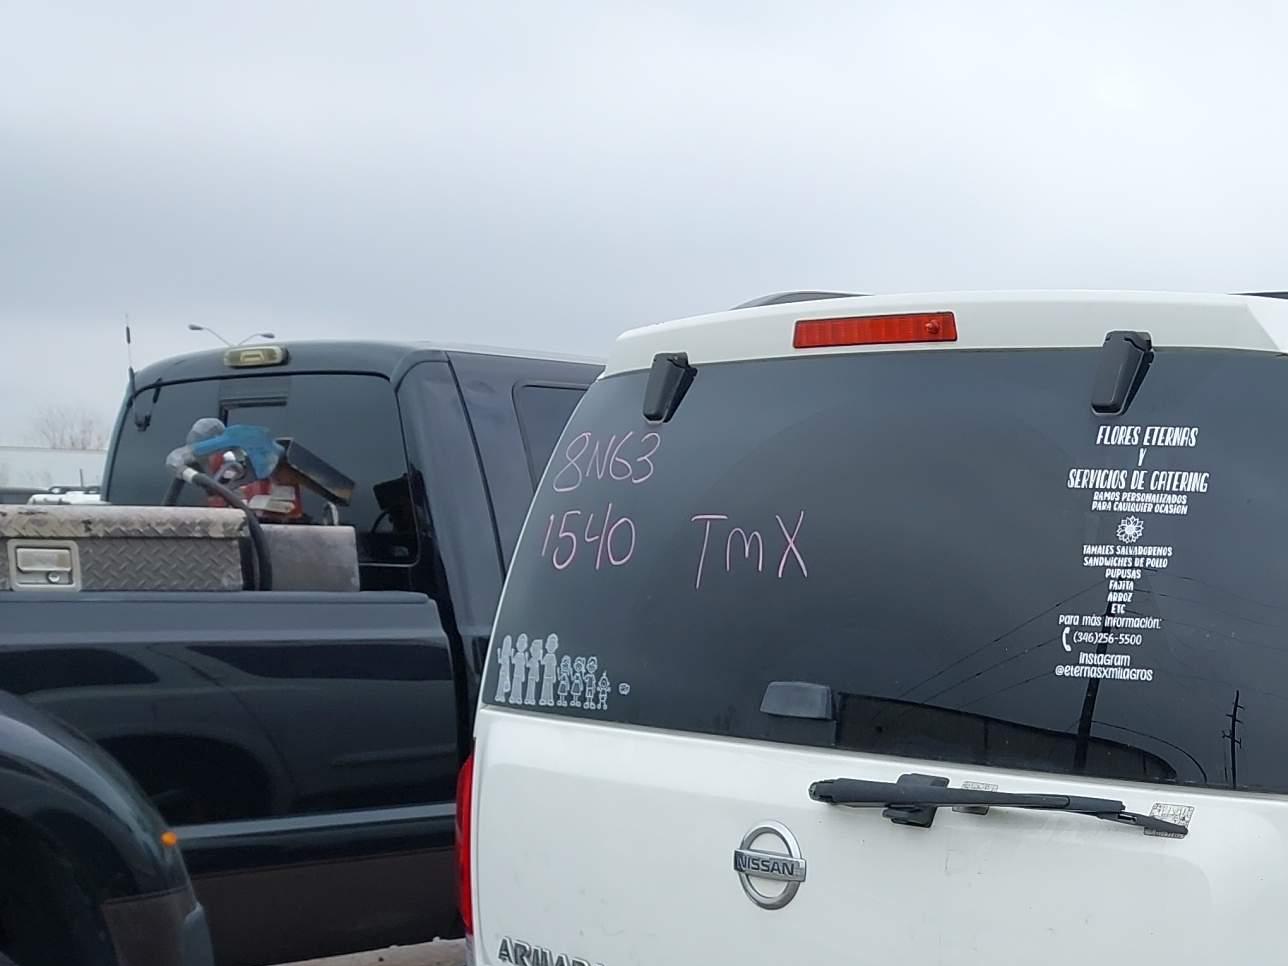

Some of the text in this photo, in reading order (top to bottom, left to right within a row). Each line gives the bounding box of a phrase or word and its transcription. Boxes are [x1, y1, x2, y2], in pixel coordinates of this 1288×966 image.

[1096, 425, 1199, 447] FLORES ETERNAS
[1067, 468, 1210, 493] SERVICIOS DE CATERING
[1093, 491, 1121, 501] RAMOS
[1091, 501, 1112, 511] PARA
[541, 503, 636, 571] 1540
[1082, 544, 1115, 555] TAMALES
[1134, 557, 1145, 567] DE
[1145, 558, 1168, 568] POLLO
[1105, 568, 1141, 579] PUPUSAS
[1108, 580, 1134, 591] FAJITA
[1107, 591, 1133, 602] ARROZ
[1110, 603, 1126, 614] ETC
[1073, 630, 1142, 645] (346)256-5500
[735, 855, 795, 876] NISSAN
